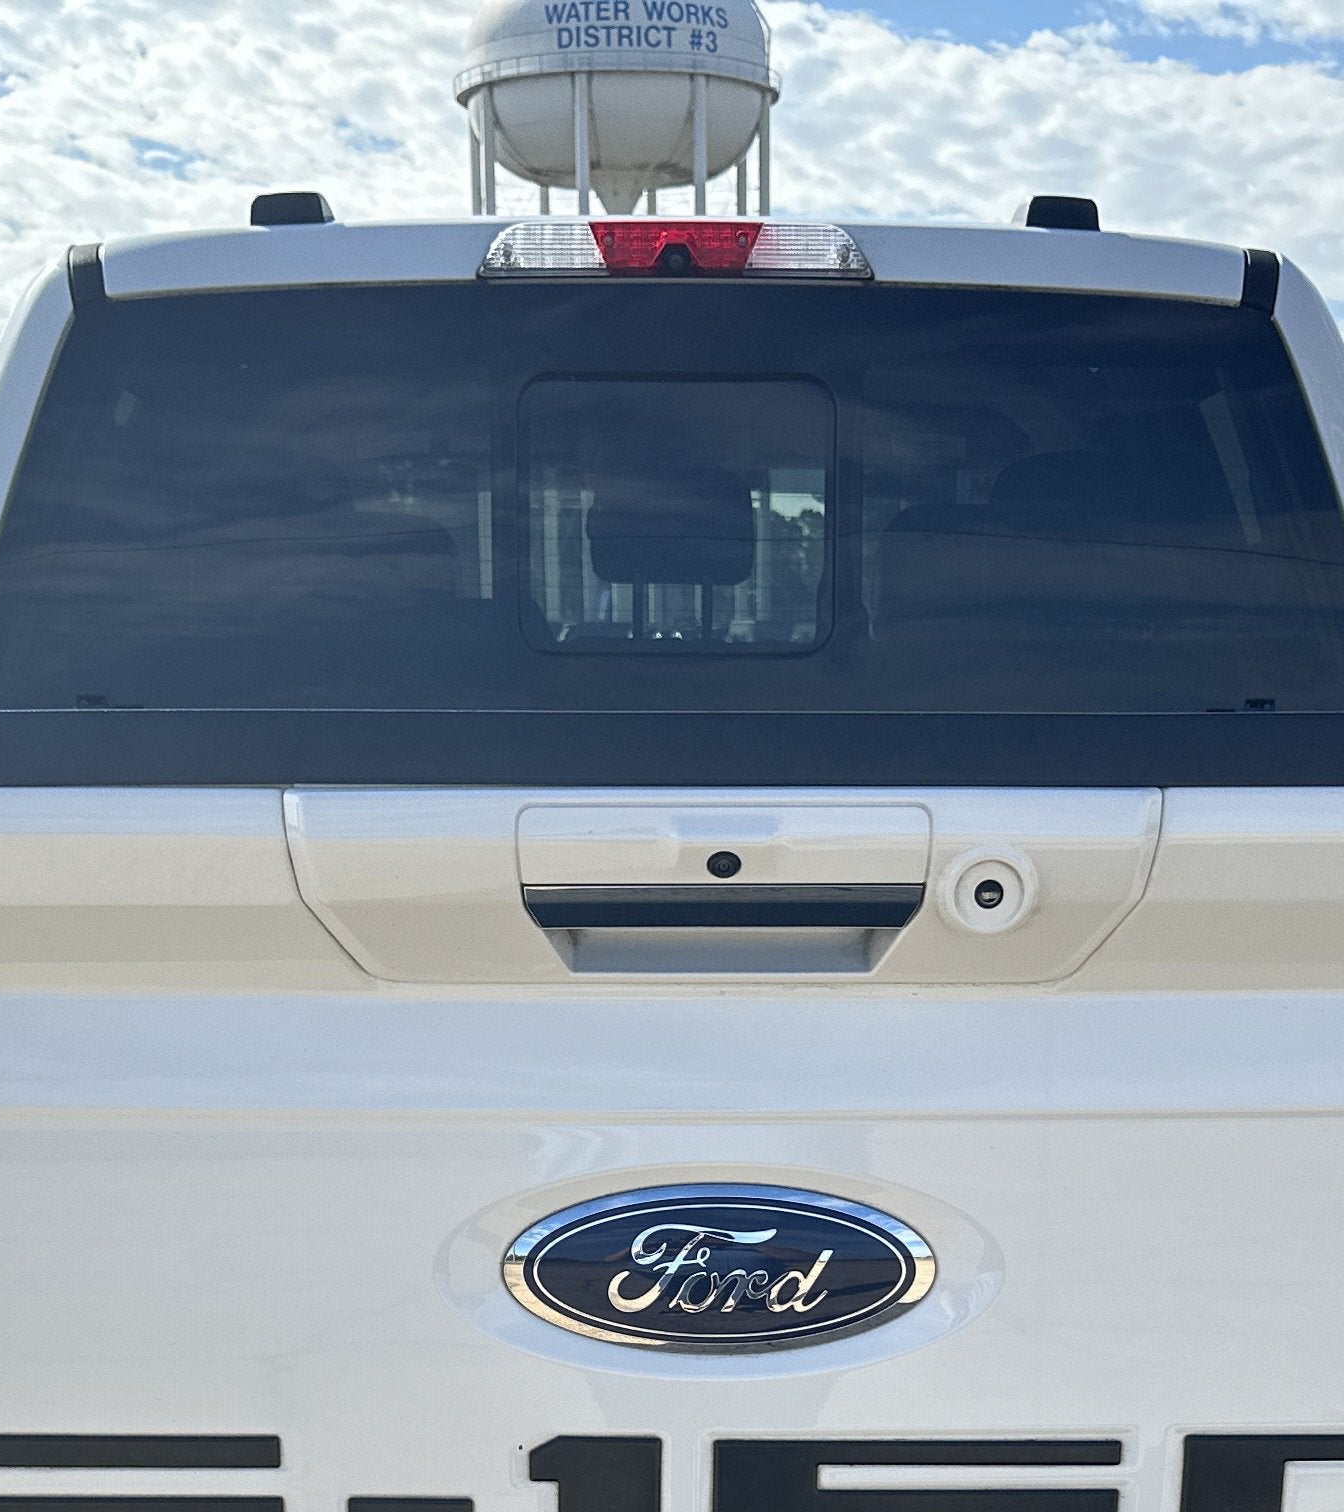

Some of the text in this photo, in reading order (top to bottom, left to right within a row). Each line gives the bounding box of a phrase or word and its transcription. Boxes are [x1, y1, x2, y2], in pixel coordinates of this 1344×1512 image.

[544, 0, 729, 29] WATER WORKS
[557, 25, 718, 53] DISTRICT #3
[607, 1222, 829, 1314] Ford
